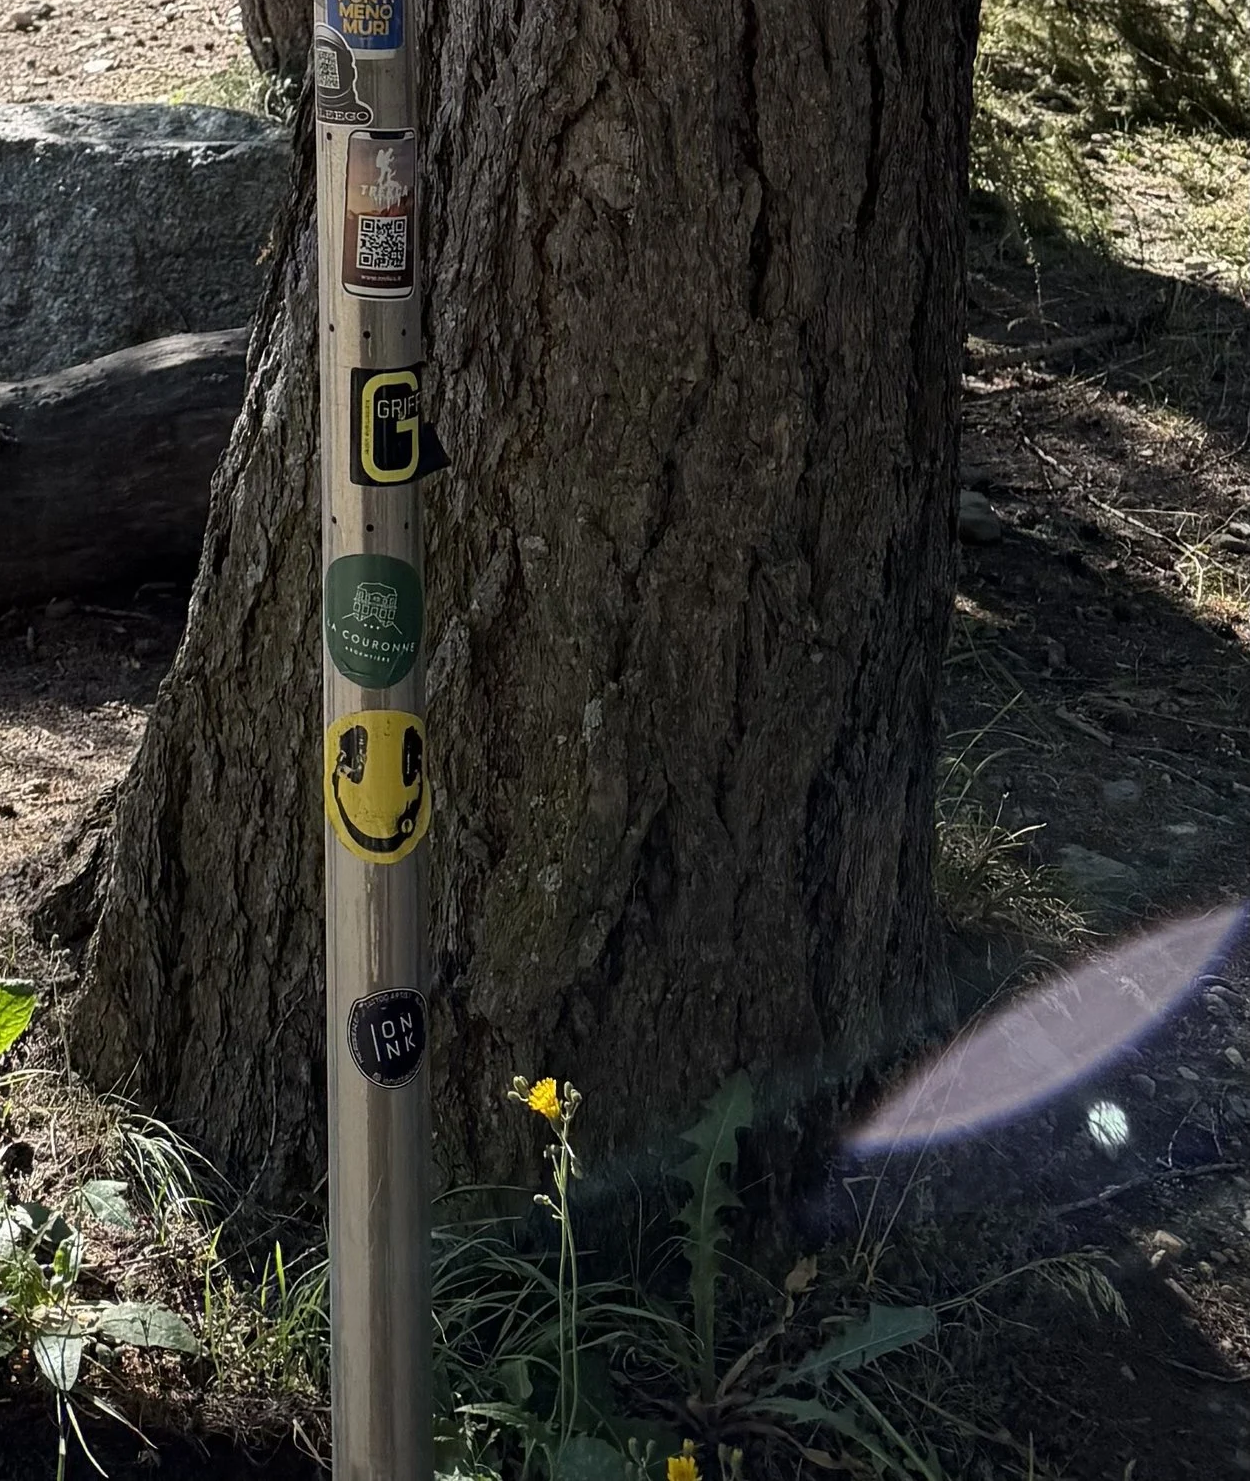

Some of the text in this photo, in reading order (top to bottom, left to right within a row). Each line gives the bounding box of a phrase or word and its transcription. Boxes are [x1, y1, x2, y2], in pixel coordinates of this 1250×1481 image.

[339, 2, 393, 19] MENO
[342, 17, 390, 35] MURI
[342, 629, 416, 653] COURONNE
